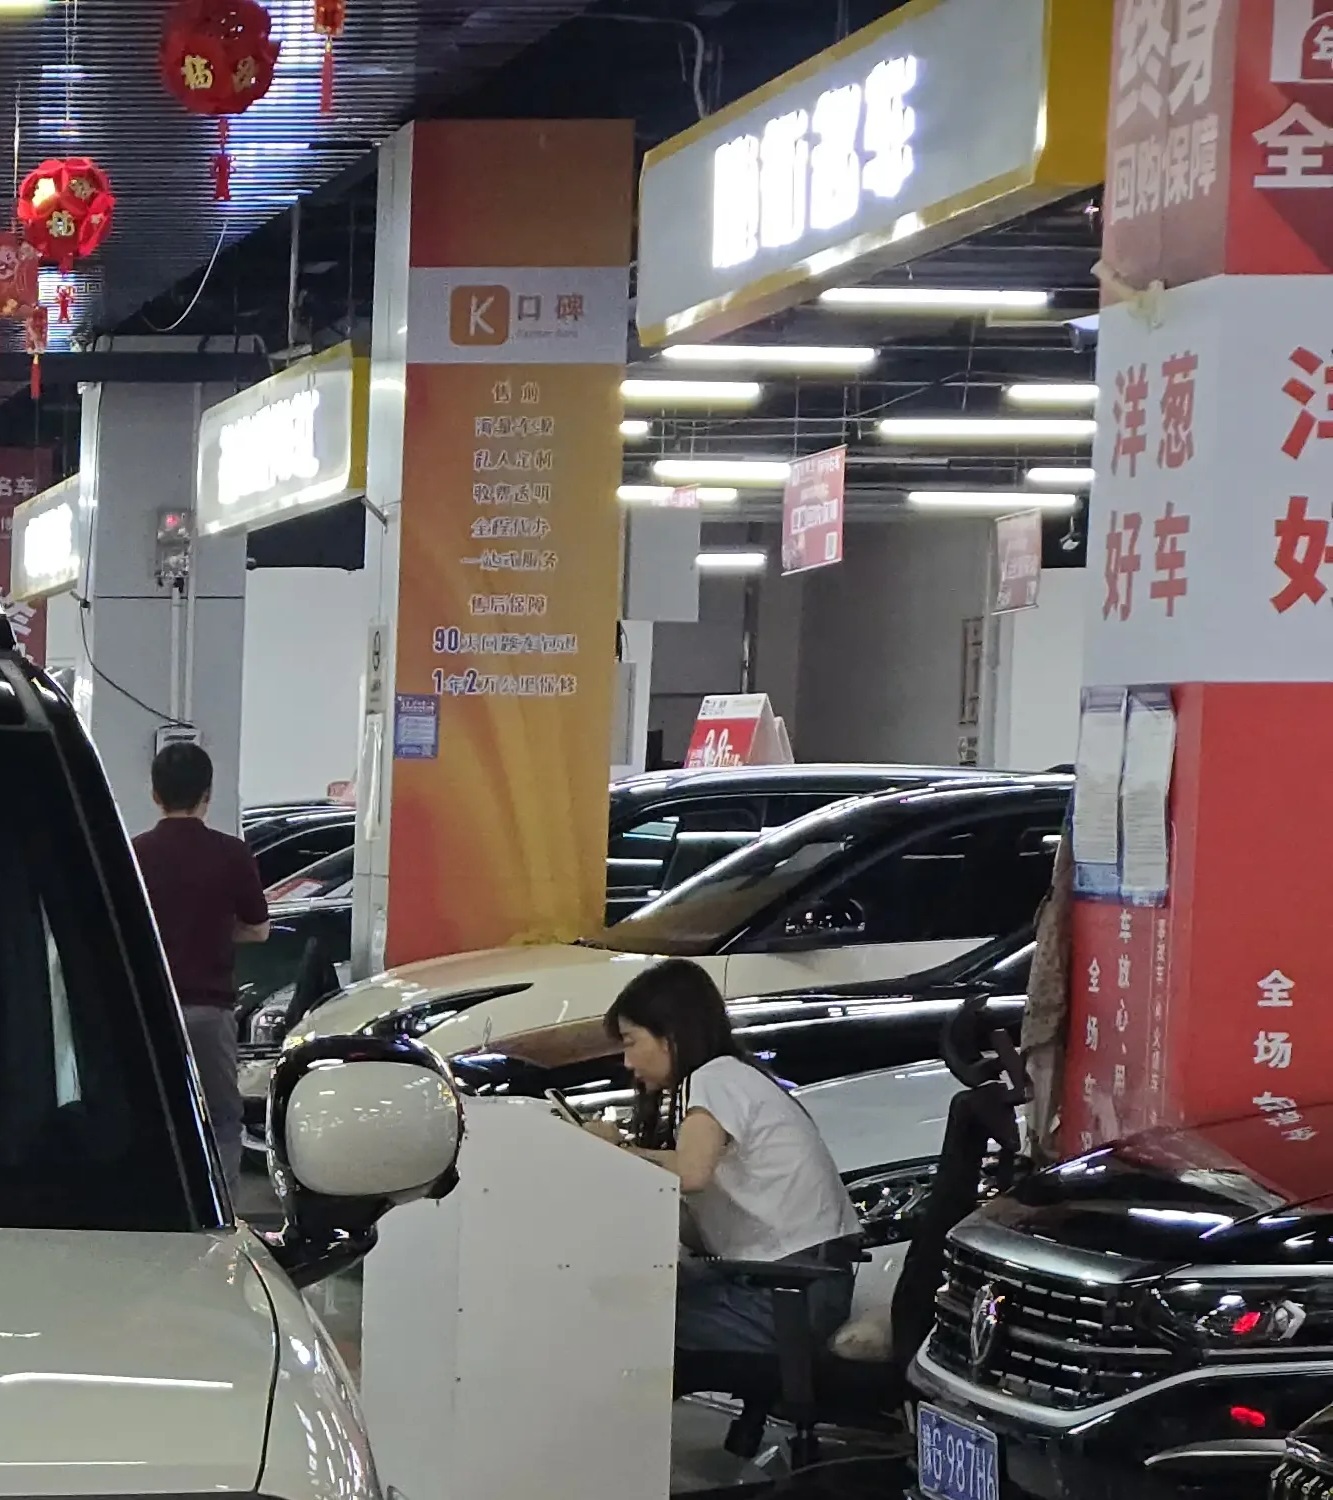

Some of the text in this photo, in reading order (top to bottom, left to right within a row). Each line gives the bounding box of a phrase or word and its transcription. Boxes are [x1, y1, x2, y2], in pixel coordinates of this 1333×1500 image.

[1109, 112, 1219, 226] 回购保障
[518, 293, 585, 322] 口碑
[1110, 350, 1199, 479] 洋葱
[473, 448, 554, 472] 私人定制
[472, 482, 552, 504] 收费透明
[470, 516, 552, 540] 全程代办
[459, 549, 559, 572] 一站式服务
[1102, 500, 1191, 622] 好车
[468, 594, 549, 617] 售后保障
[431, 667, 580, 697] 1年2万公里保修
